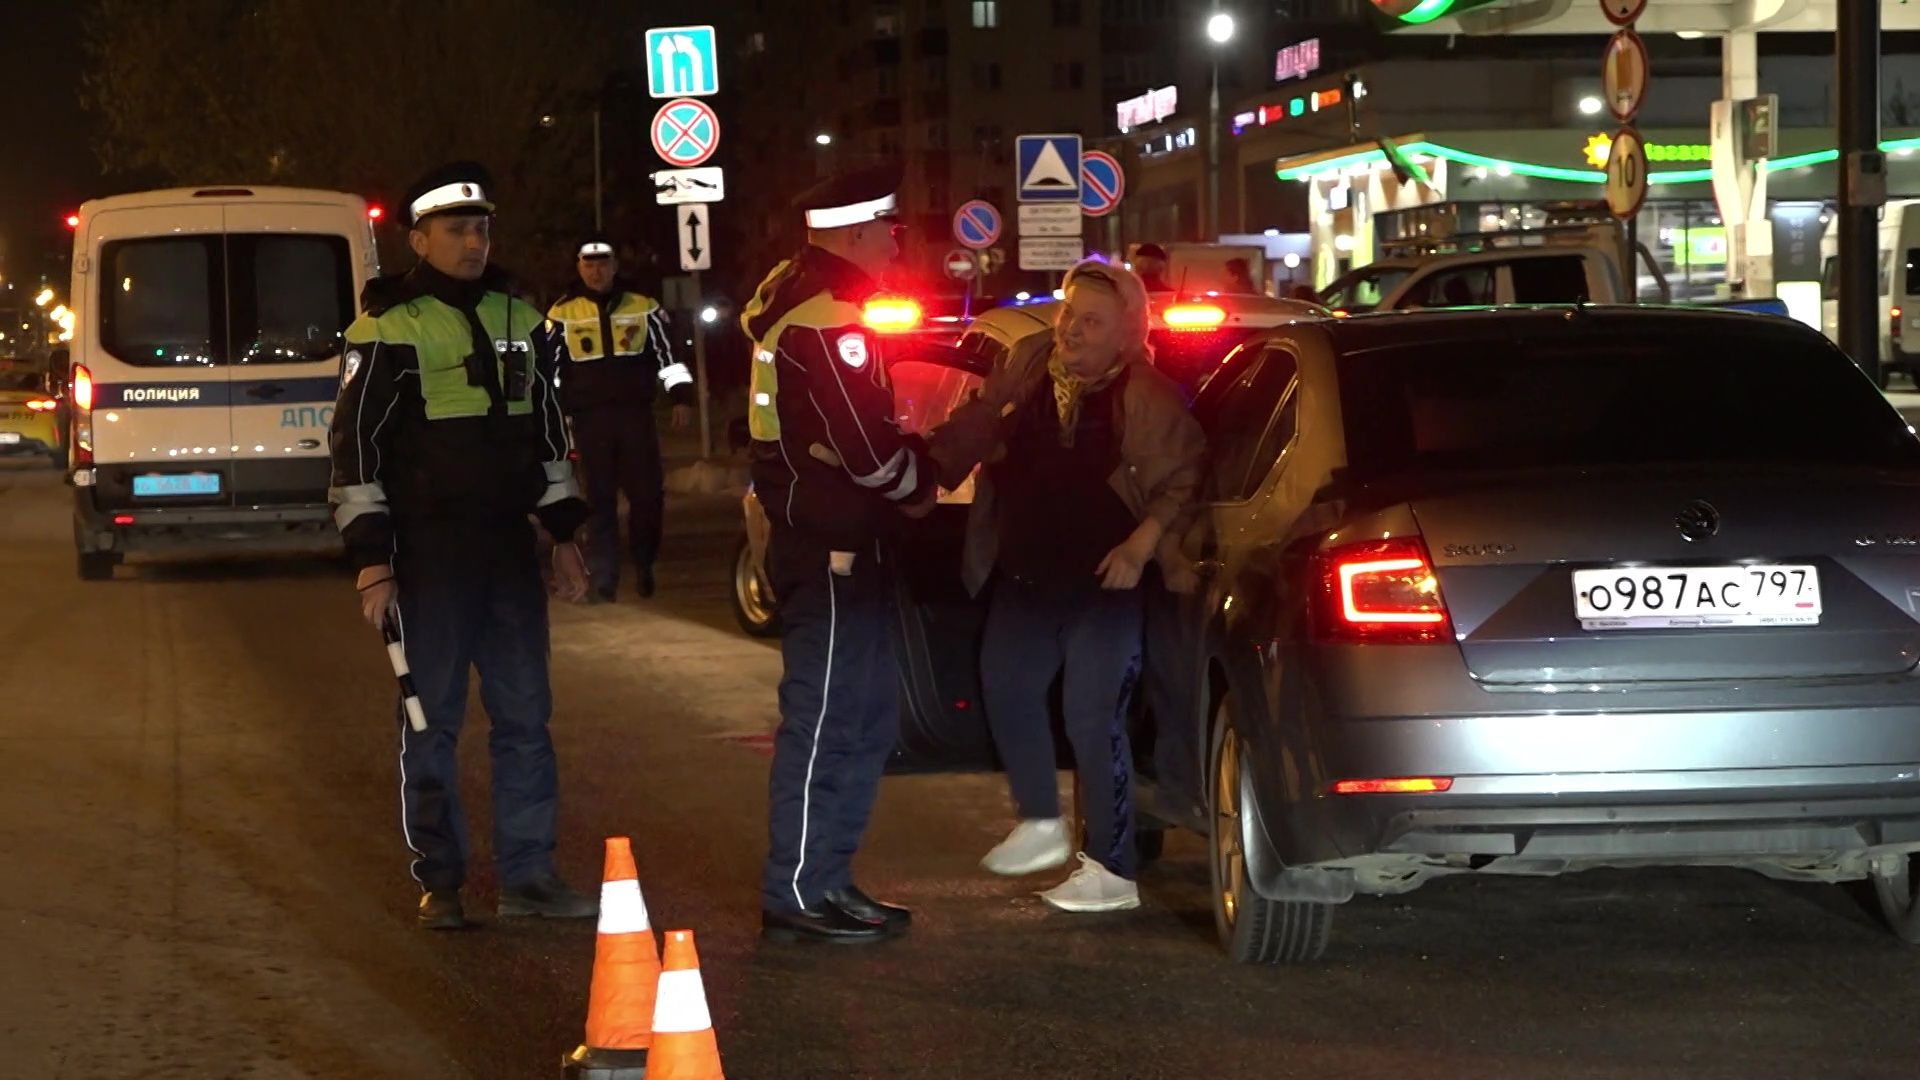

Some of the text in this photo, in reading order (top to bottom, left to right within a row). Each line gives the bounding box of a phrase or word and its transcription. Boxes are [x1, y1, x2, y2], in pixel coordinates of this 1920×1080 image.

[1617, 153, 1636, 188] 10
[123, 387, 200, 402] ПОЛИЦИЯ
[1750, 569, 1807, 597] 797
